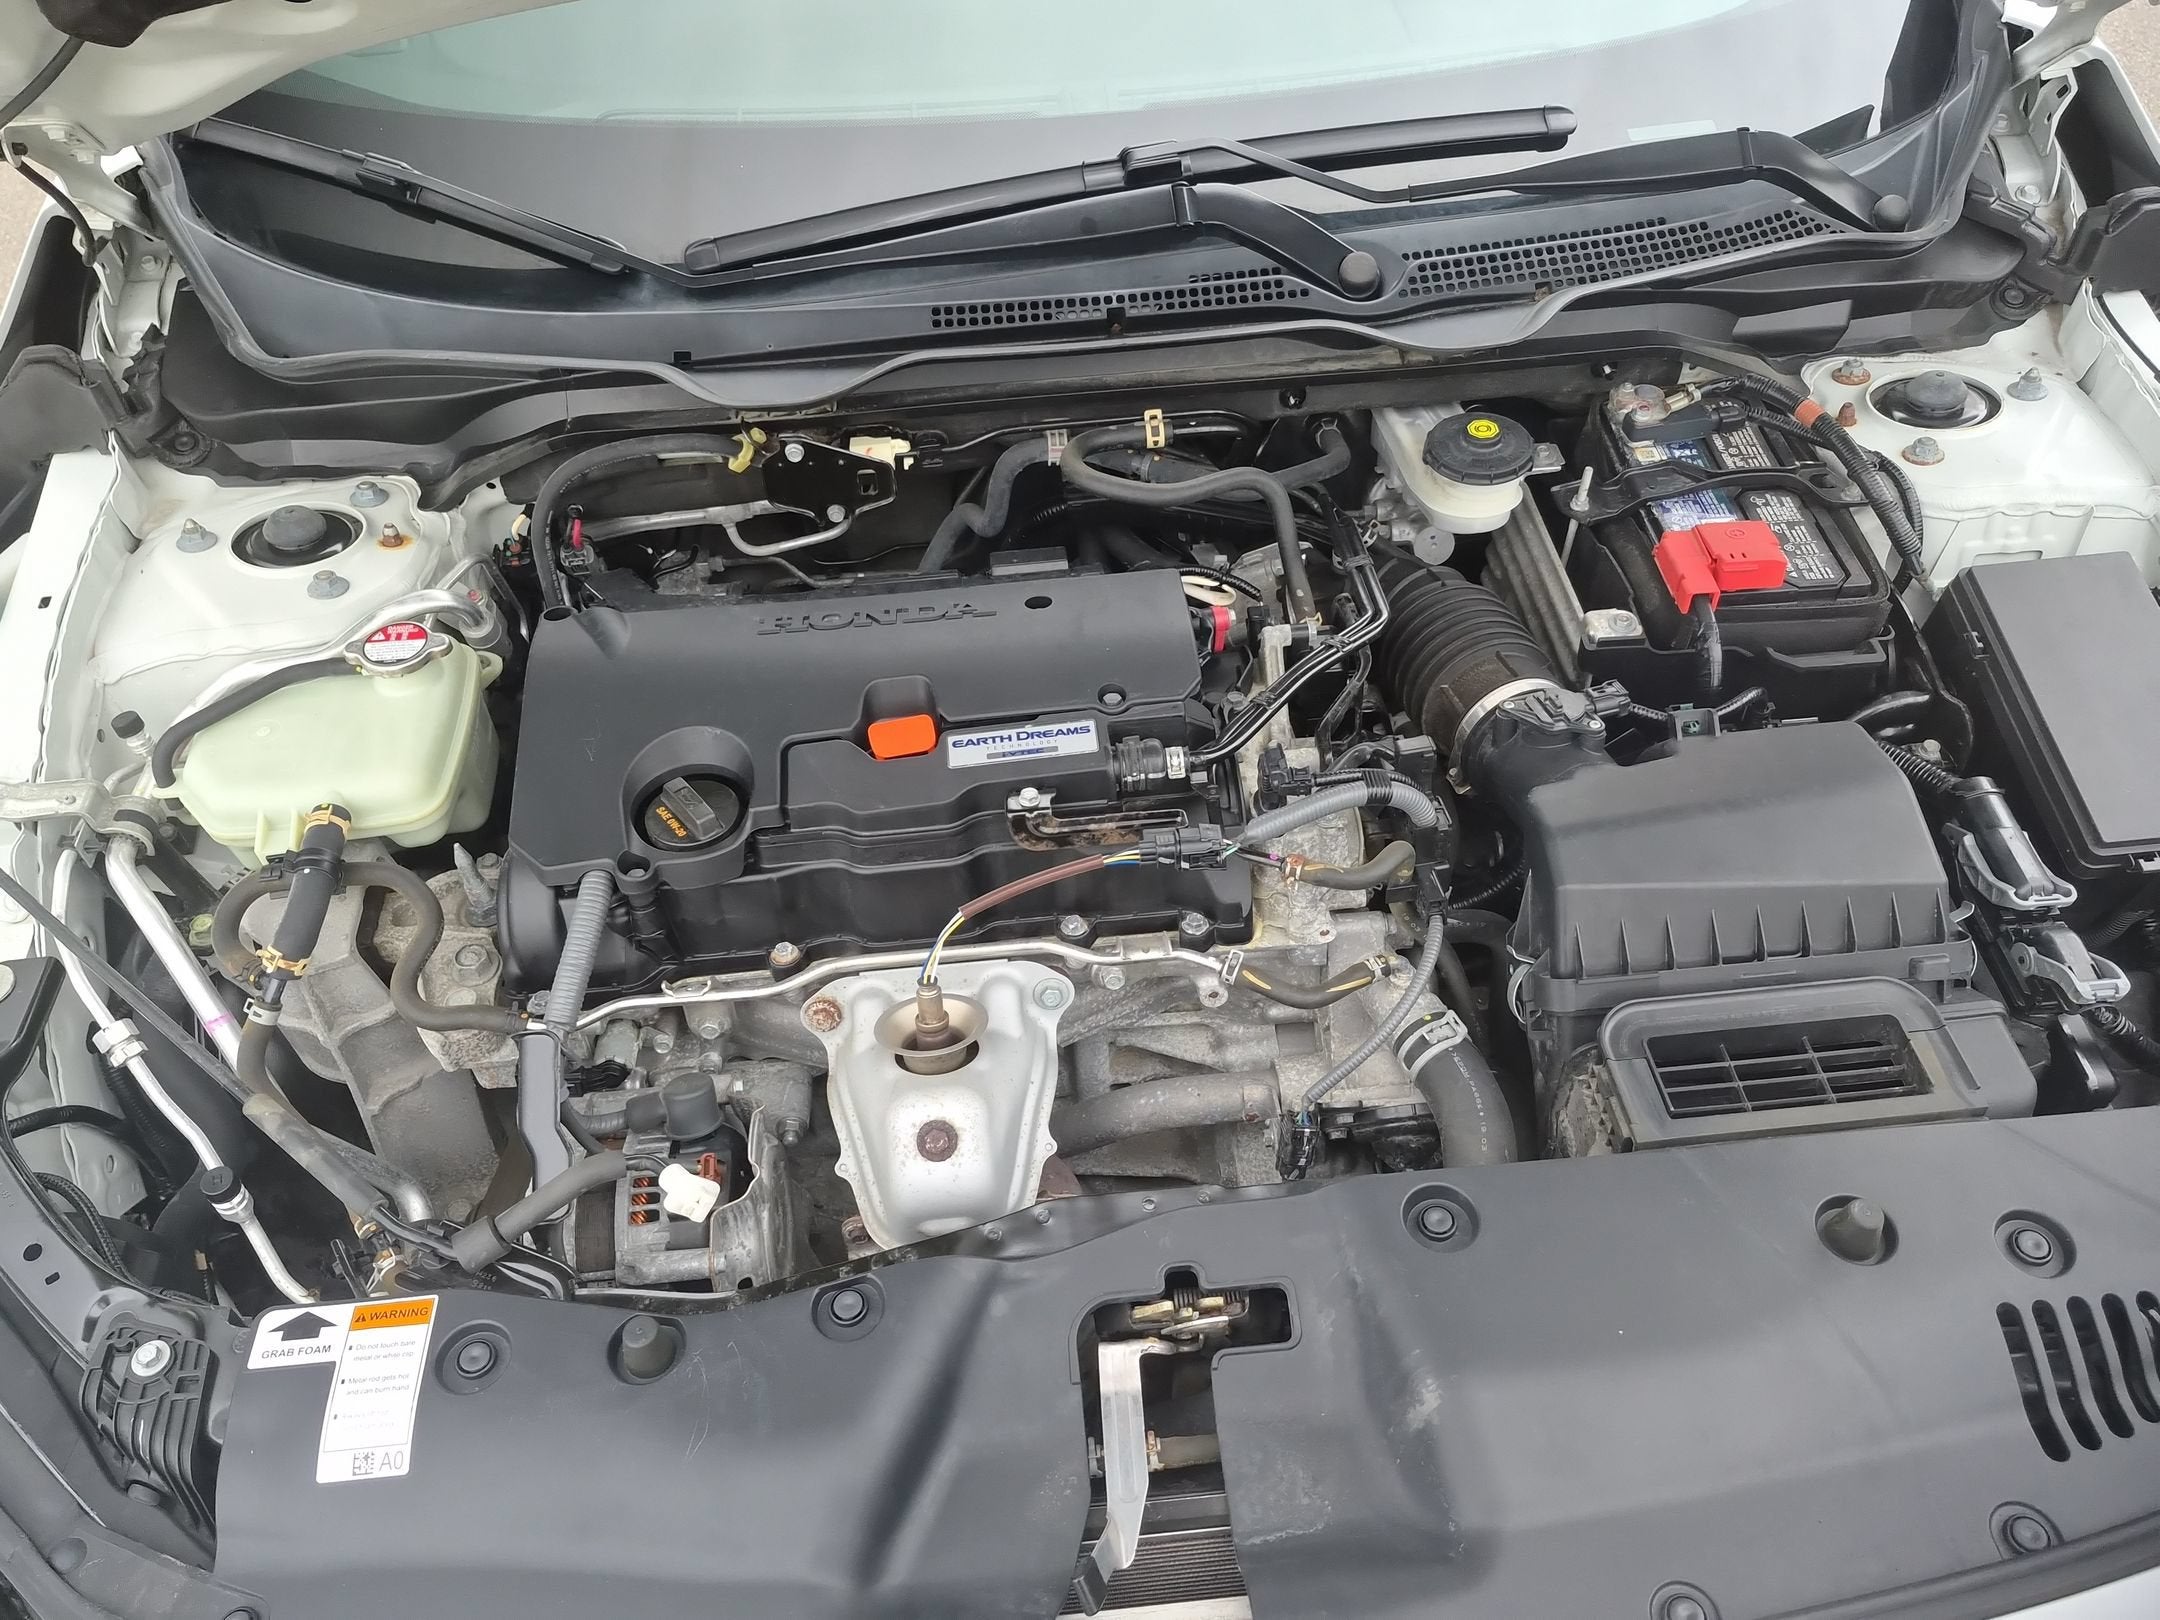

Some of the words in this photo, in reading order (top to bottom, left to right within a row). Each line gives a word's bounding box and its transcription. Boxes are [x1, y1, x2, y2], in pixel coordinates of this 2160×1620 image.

[753, 603, 997, 635] HONDA
[951, 734, 1012, 748] EARTH
[1016, 725, 1091, 741] DREAMS
[986, 740, 1058, 751] TECHNOLOGY
[655, 806, 671, 821] SAE
[667, 817, 687, 837] 0W-20
[369, 1307, 429, 1321] WARNING
[261, 1346, 295, 1360] GRAB
[297, 1344, 332, 1356] FOAM
[379, 1450, 404, 1471] A0
